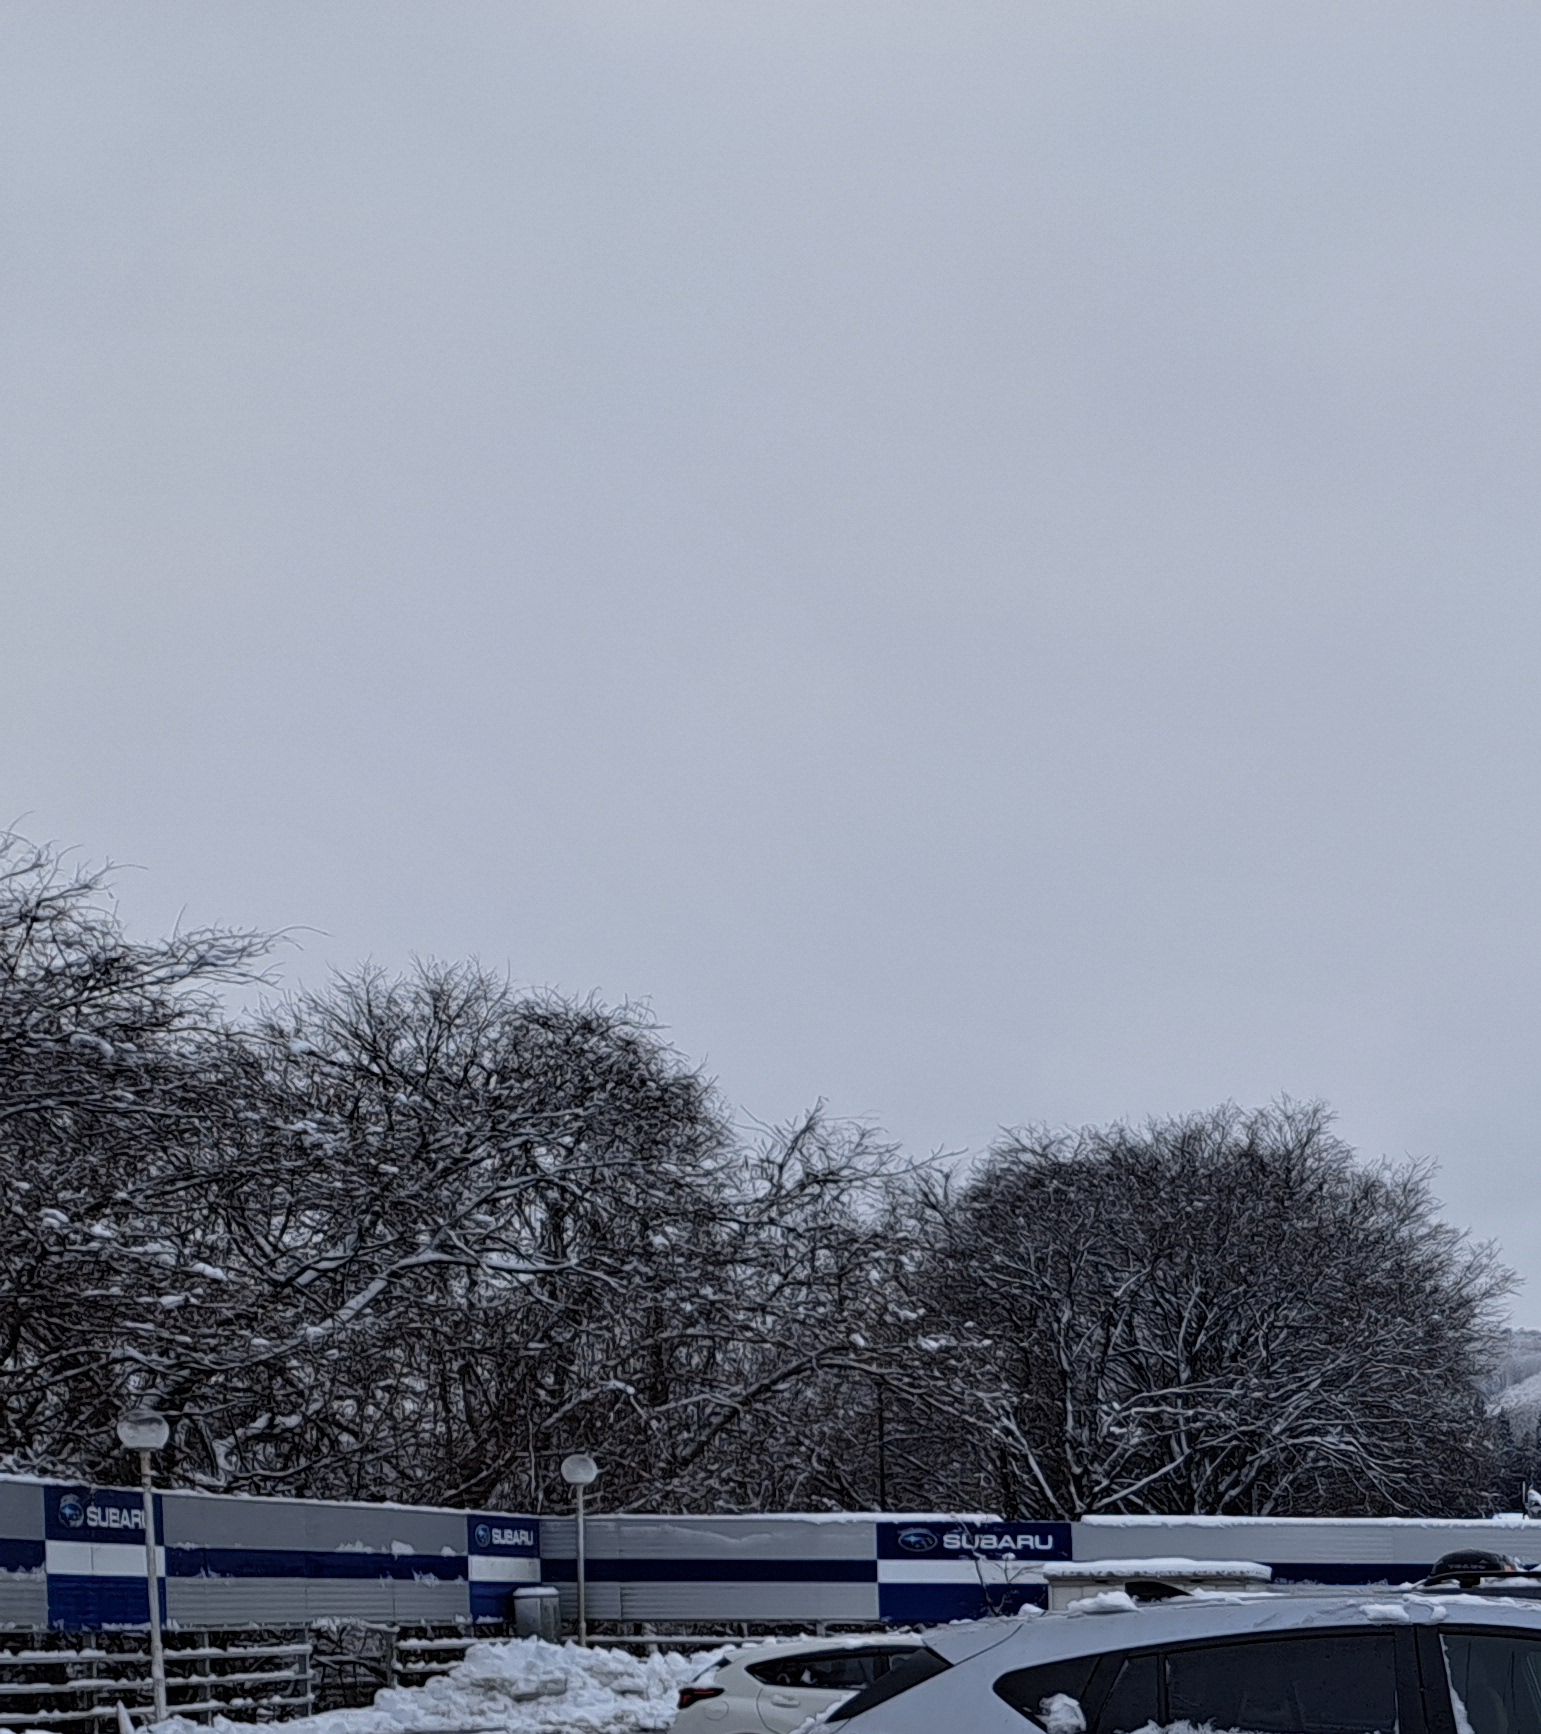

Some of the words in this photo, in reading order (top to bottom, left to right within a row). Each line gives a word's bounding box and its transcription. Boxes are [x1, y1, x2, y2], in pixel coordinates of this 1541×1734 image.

[86, 1505, 146, 1530] SUBAR
[491, 1528, 534, 1546] SUBARU
[943, 1534, 1054, 1550] SUBARU
